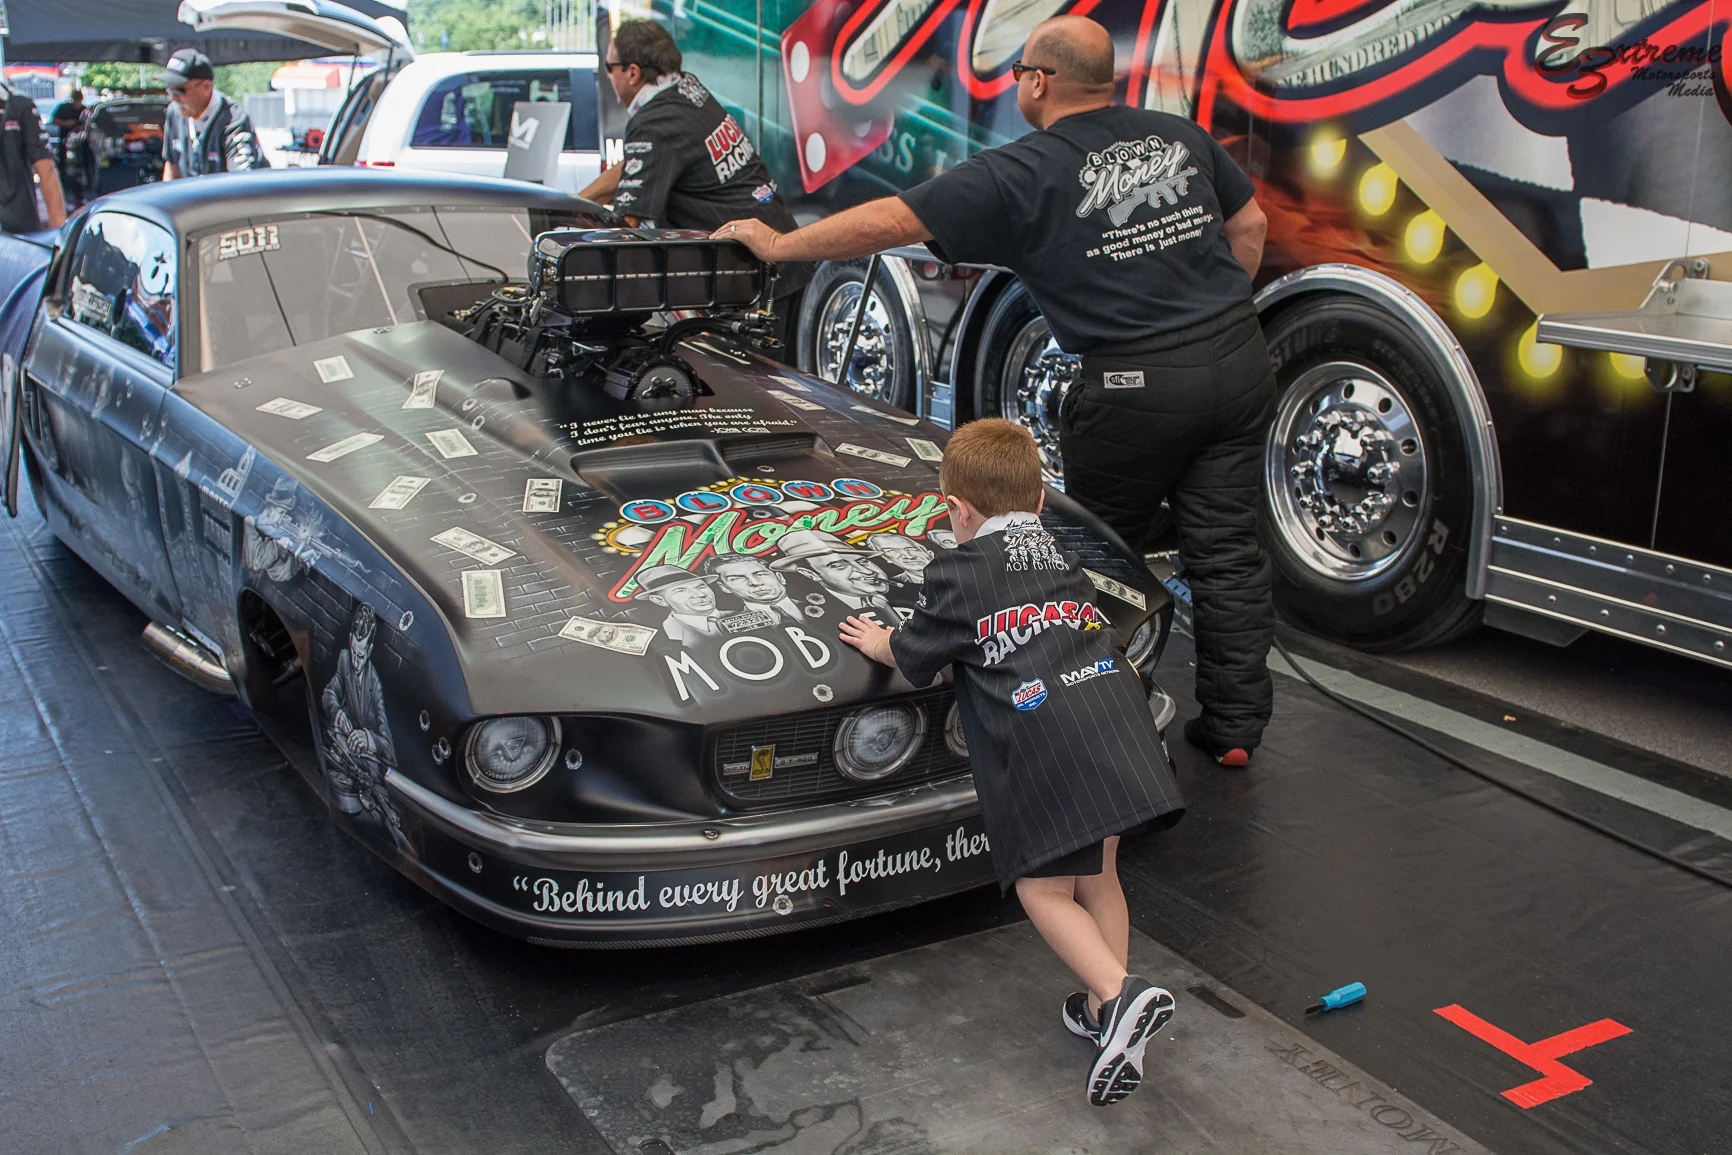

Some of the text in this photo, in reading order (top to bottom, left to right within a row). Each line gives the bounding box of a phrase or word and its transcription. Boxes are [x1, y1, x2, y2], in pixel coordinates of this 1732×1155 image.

[1090, 137, 1162, 166] BLOWN
[1077, 142, 1188, 217] Money
[1147, 219, 1160, 230] no
[1160, 213, 1182, 225] such
[1182, 204, 1204, 218] thing
[1086, 248, 1101, 258] as
[1102, 238, 1130, 255] good
[1132, 229, 1164, 245] money
[1165, 225, 1176, 234] or
[1178, 217, 1193, 231] bad
[1110, 247, 1144, 262] There
[1145, 243, 1156, 253] is
[1159, 237, 1178, 250] just
[569, 430, 579, 438] I
[583, 425, 617, 436] don't
[618, 421, 648, 431] fear
[724, 412, 753, 420] only
[577, 435, 607, 446] time
[608, 431, 635, 441] you
[635, 427, 654, 435] lie
[669, 420, 703, 429] when
[582, 417, 618, 428] never
[618, 414, 637, 422] lie
[636, 411, 652, 419] to
[652, 408, 679, 418] any
[631, 480, 880, 521] BLOWN
[609, 493, 949, 602] Money
[1372, 516, 1450, 616] R280
[664, 625, 831, 701] MOB
[1016, 683, 1041, 703] LUCAS
[658, 876, 744, 912] every
[752, 859, 830, 909] great
[836, 847, 942, 896] fortune,
[945, 826, 991, 861] ther
